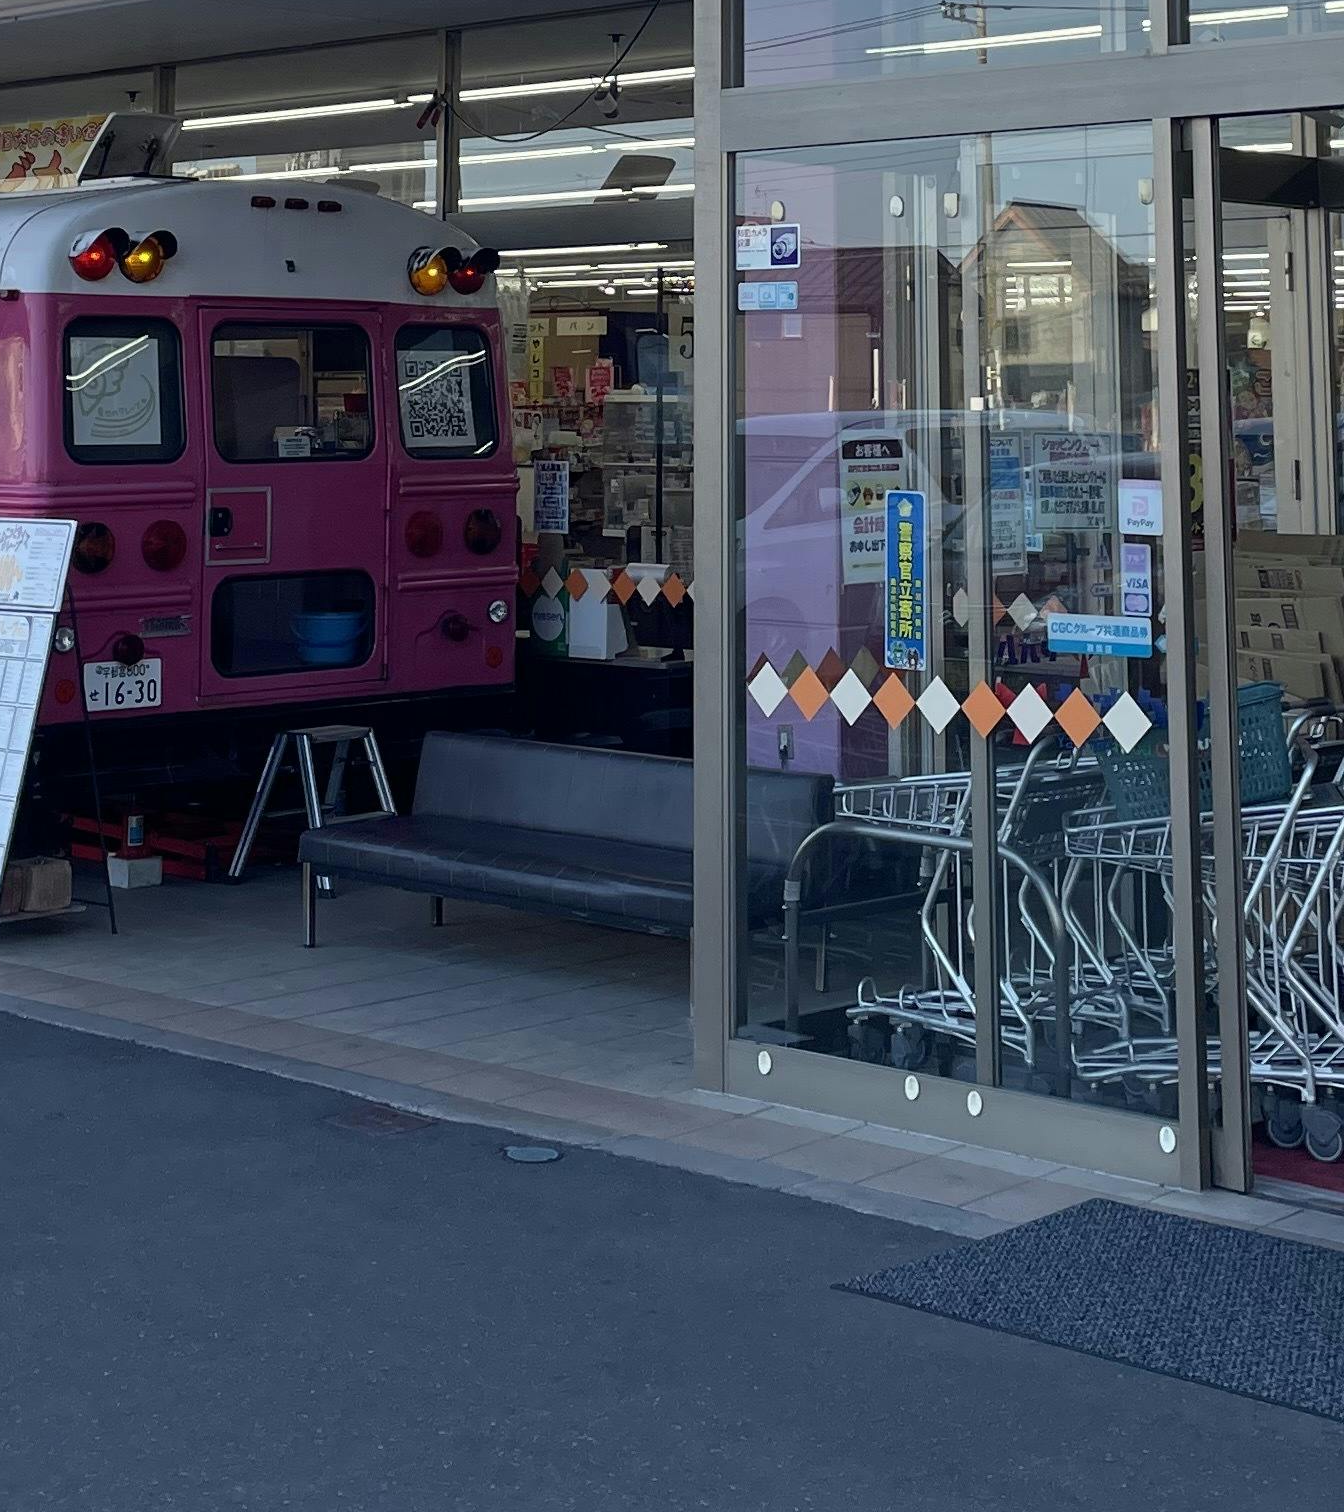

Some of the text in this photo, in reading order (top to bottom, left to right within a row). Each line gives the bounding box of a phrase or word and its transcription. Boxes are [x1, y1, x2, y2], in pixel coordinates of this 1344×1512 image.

[855, 444, 891, 458] お客様へ
[1126, 518, 1155, 528] PayPay
[1126, 578, 1149, 589] VISA
[1051, 621, 1149, 639] CGCグループ共通商品券
[89, 678, 157, 706] せ 16-30
